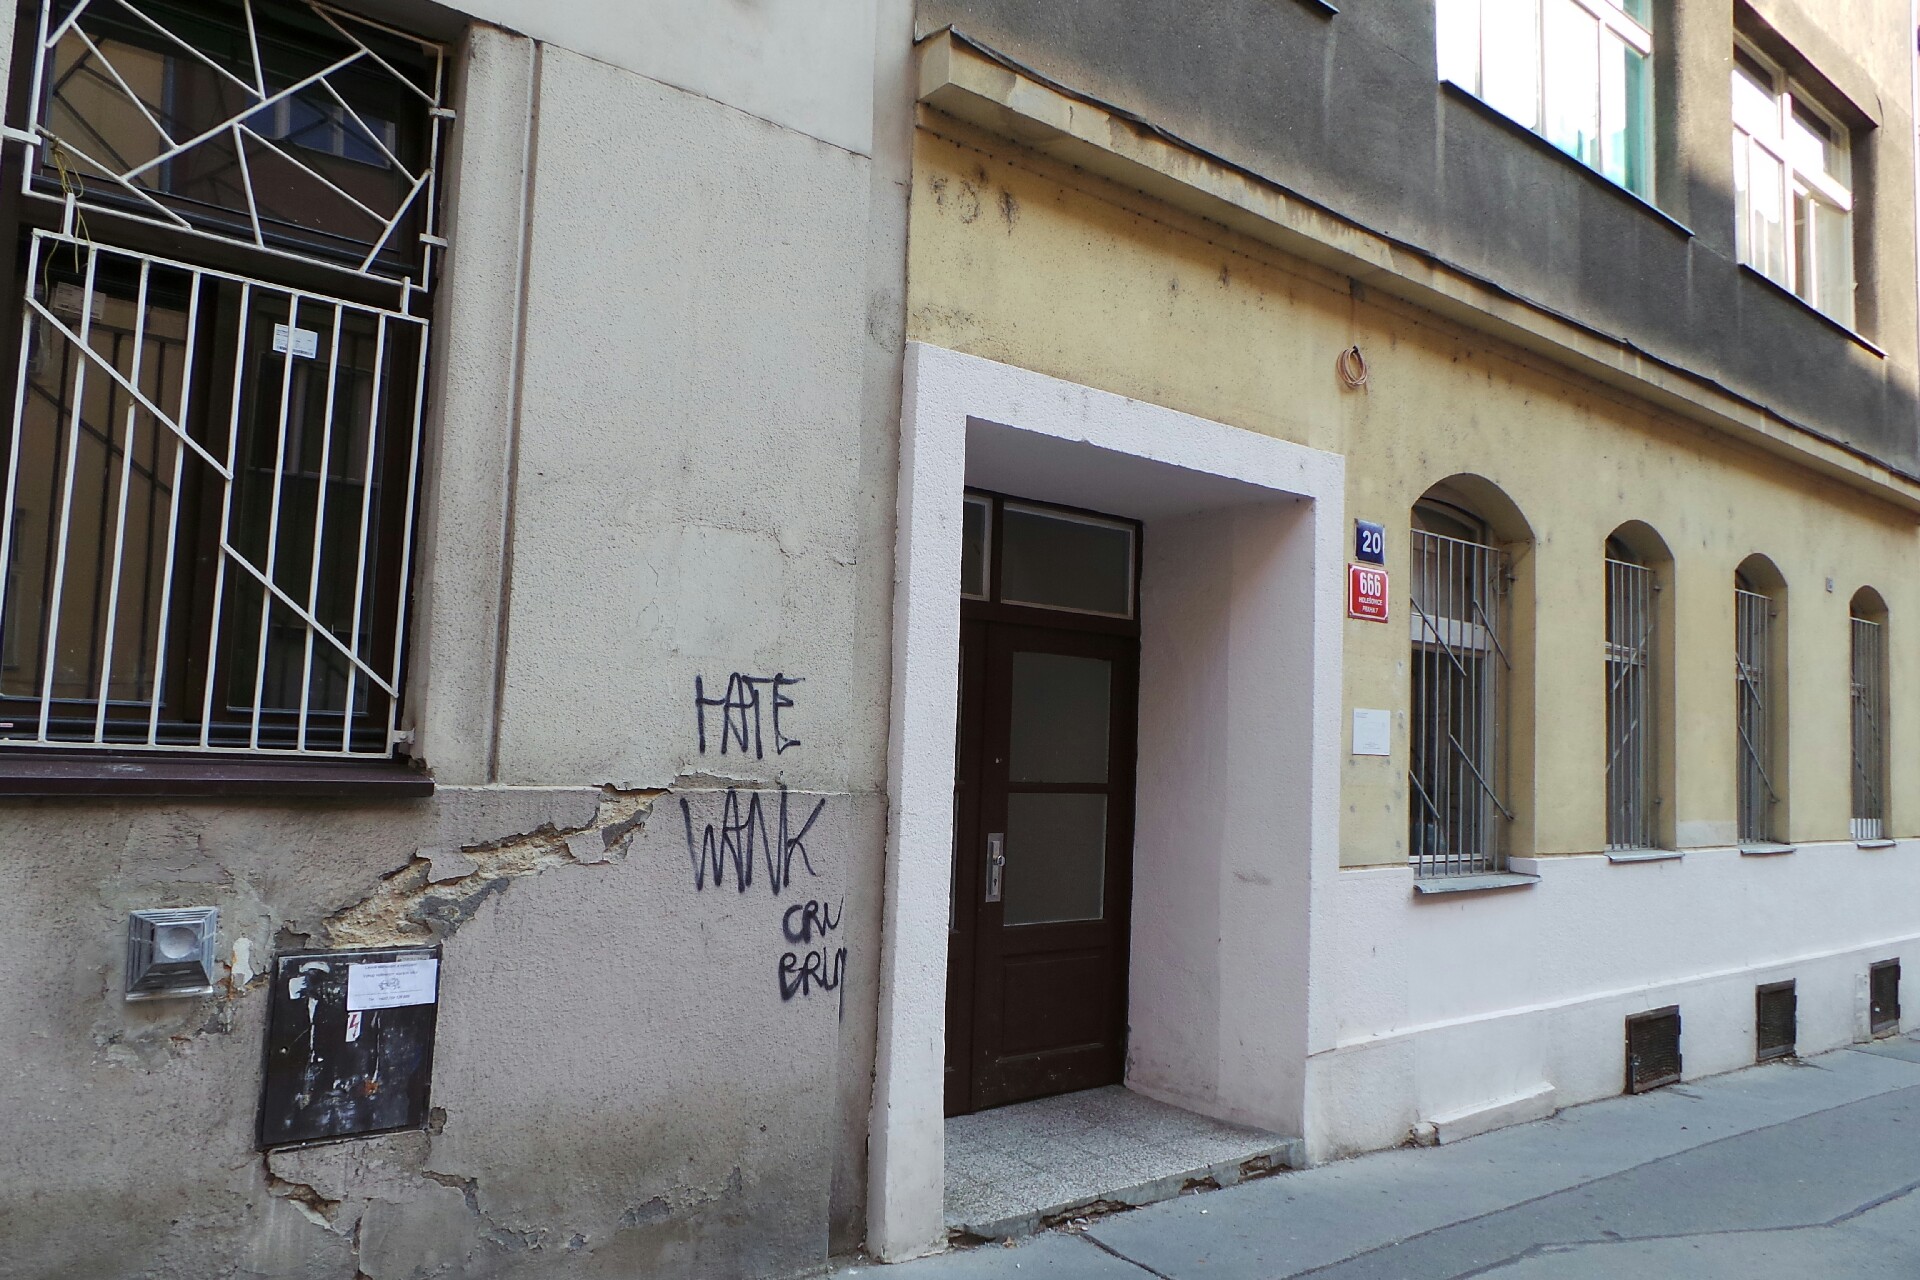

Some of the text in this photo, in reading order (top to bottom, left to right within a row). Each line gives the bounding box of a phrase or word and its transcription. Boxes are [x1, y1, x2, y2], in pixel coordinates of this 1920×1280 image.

[1362, 530, 1381, 554] 20
[1360, 572, 1381, 597] 666
[695, 672, 804, 760] HATE
[680, 784, 825, 896] WANK
